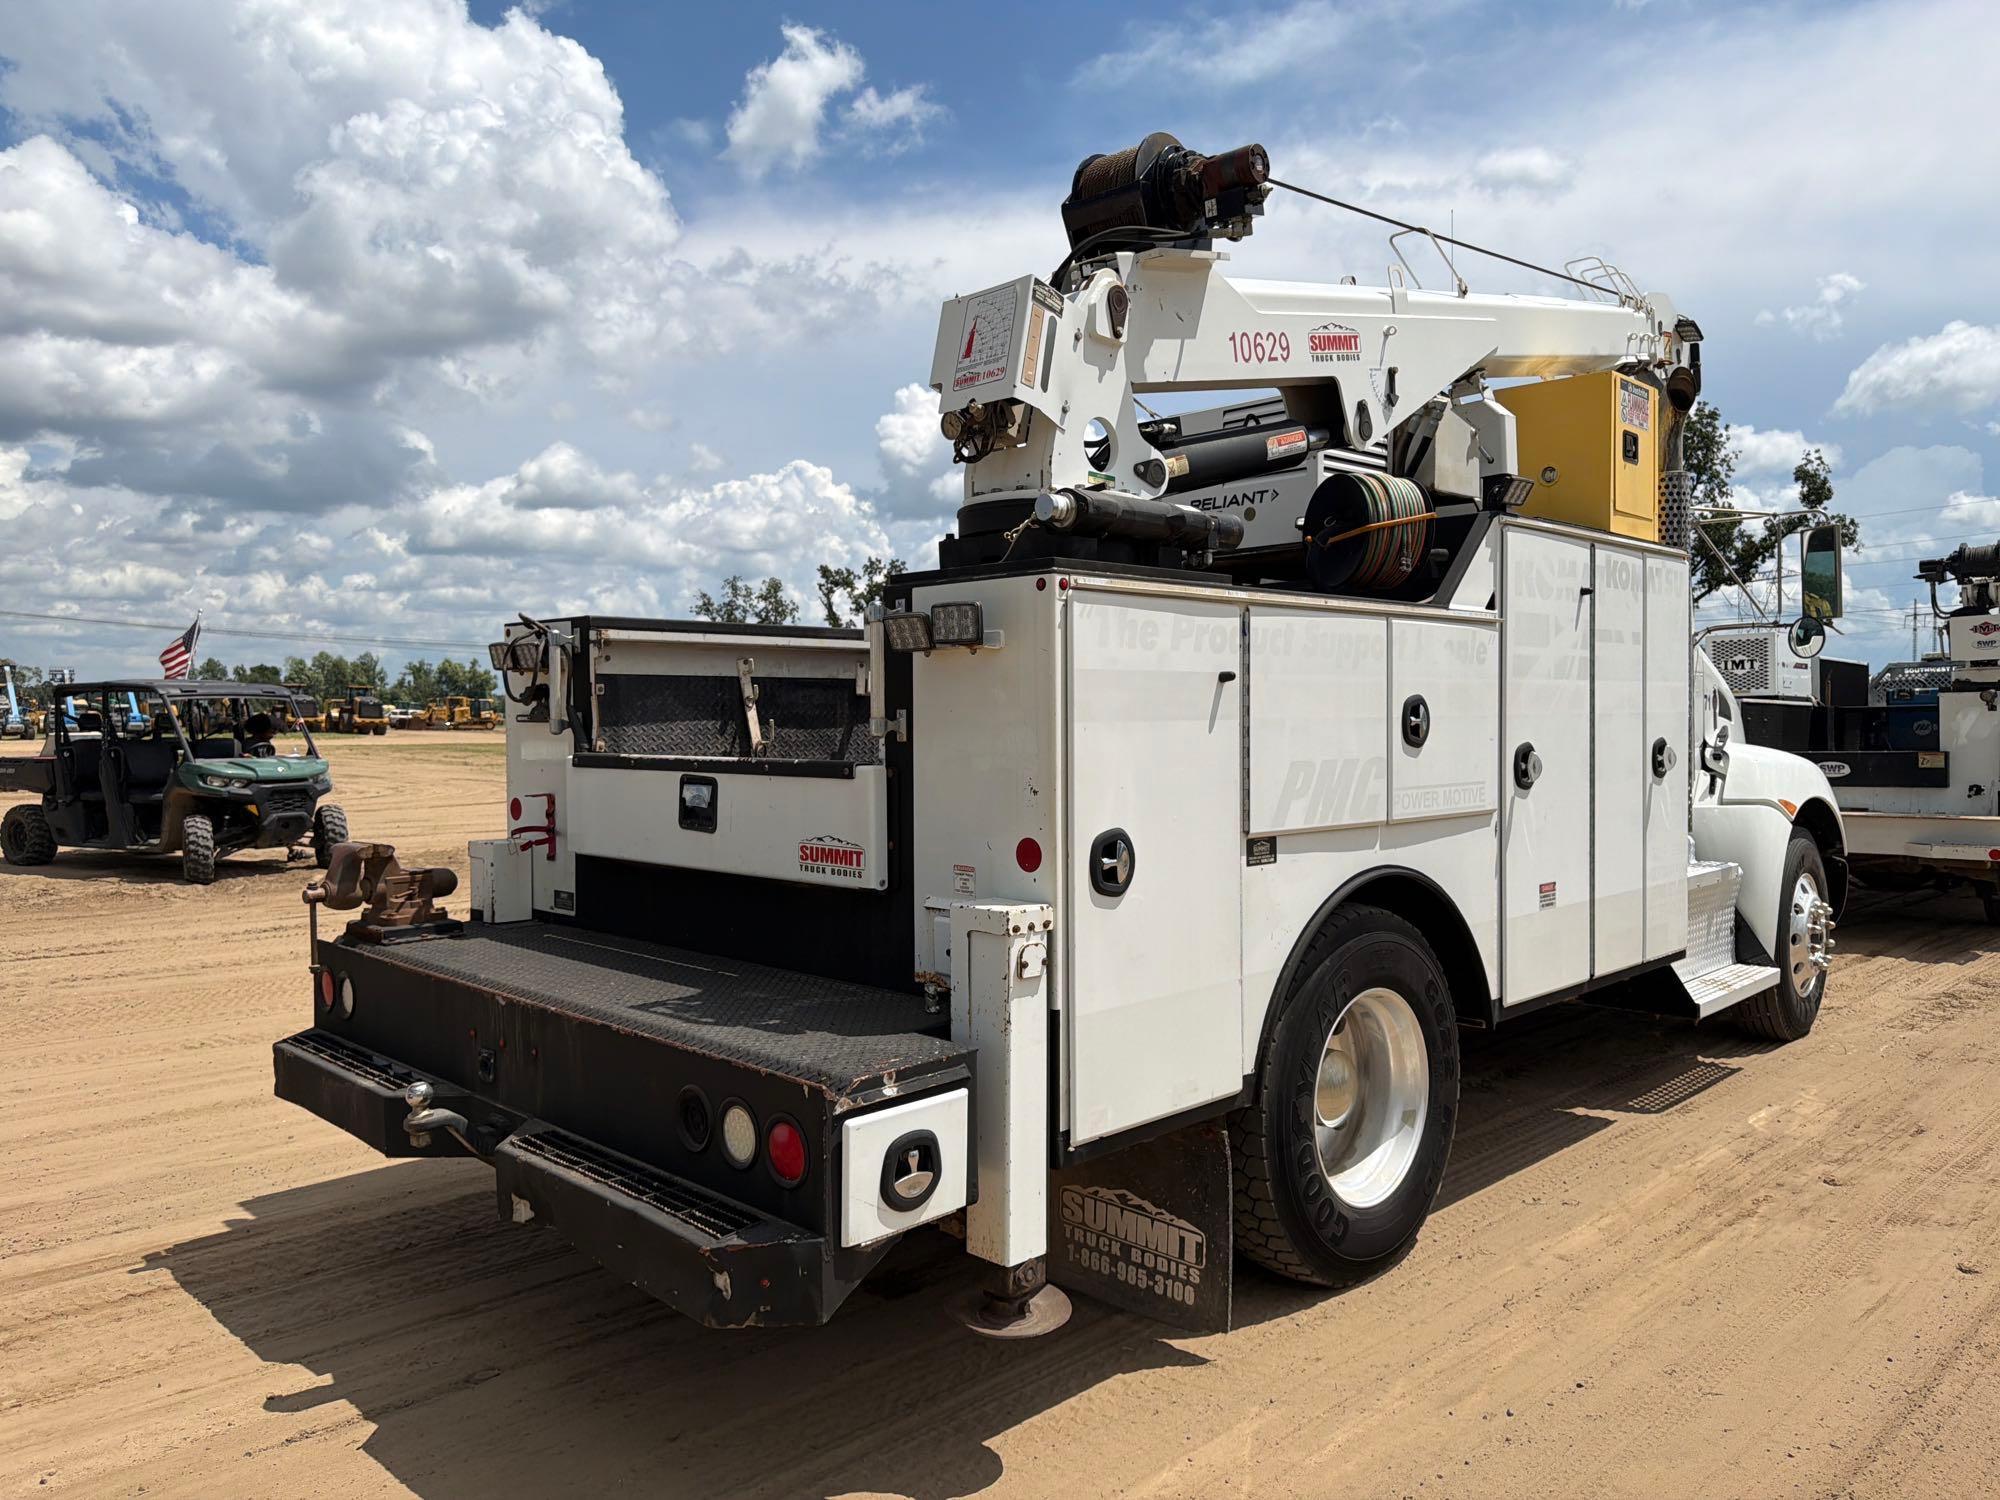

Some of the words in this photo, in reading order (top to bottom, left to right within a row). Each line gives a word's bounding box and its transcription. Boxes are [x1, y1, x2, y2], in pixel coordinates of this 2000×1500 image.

[1229, 331, 1290, 364] 10629
[1309, 335, 1359, 351] SUMMIT
[1311, 354, 1334, 362] TRUCK
[1336, 353, 1360, 362] BODIES
[955, 373, 981, 388] SUMMIT
[982, 366, 1005, 380] 10629
[1190, 490, 1269, 512] RELIANT
[1721, 659, 1757, 671] IMT
[1819, 764, 1846, 773] SWP
[1394, 789, 1442, 810] POWER
[1443, 786, 1486, 807] MOTIVE
[799, 845, 864, 868] SUMMIT
[800, 864, 826, 874] TRUCK
[831, 868, 862, 879] BODIES
[1062, 1190, 1203, 1264] SUMMIT
[1063, 1224, 1121, 1256] TRUCK
[1131, 1248, 1200, 1284] BODIES
[1067, 1243, 1195, 1306] 1-866-985-3100
